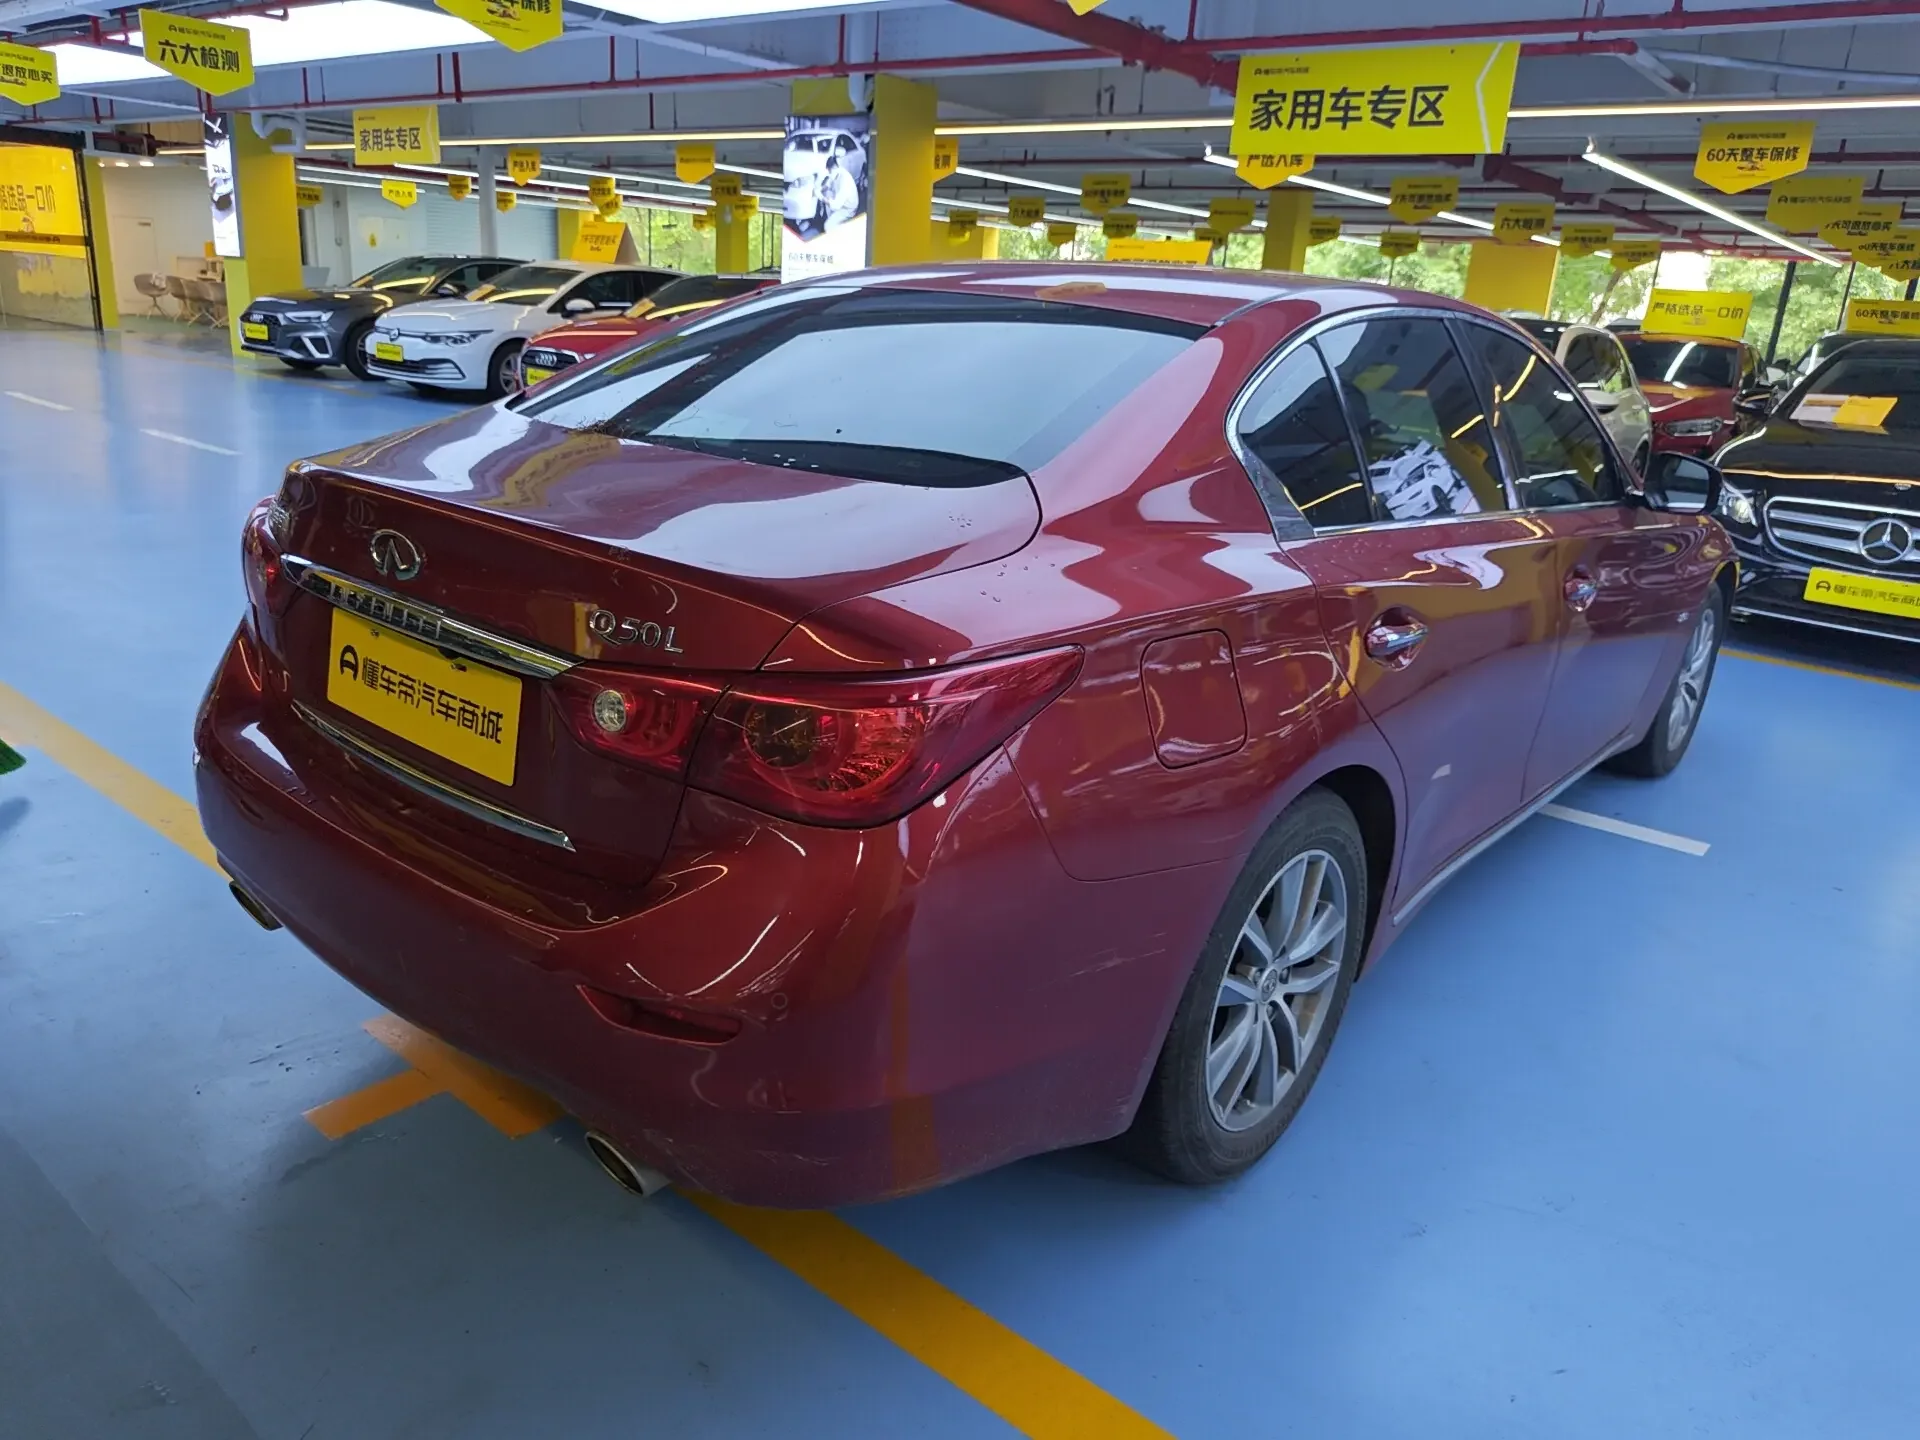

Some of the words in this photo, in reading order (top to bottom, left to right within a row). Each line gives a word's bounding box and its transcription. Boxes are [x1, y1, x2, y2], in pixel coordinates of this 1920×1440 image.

[158, 39, 240, 73] 六大检测
[0, 63, 52, 84] 退放心买
[1249, 85, 1449, 131] 家用车专区
[359, 127, 421, 153] 家用车专区
[1706, 146, 1800, 162] 60天整车保修
[1651, 302, 1744, 320] 严格选品一口价
[589, 609, 684, 654] Q50L
[361, 655, 504, 744] 懂车帝汽车商城
